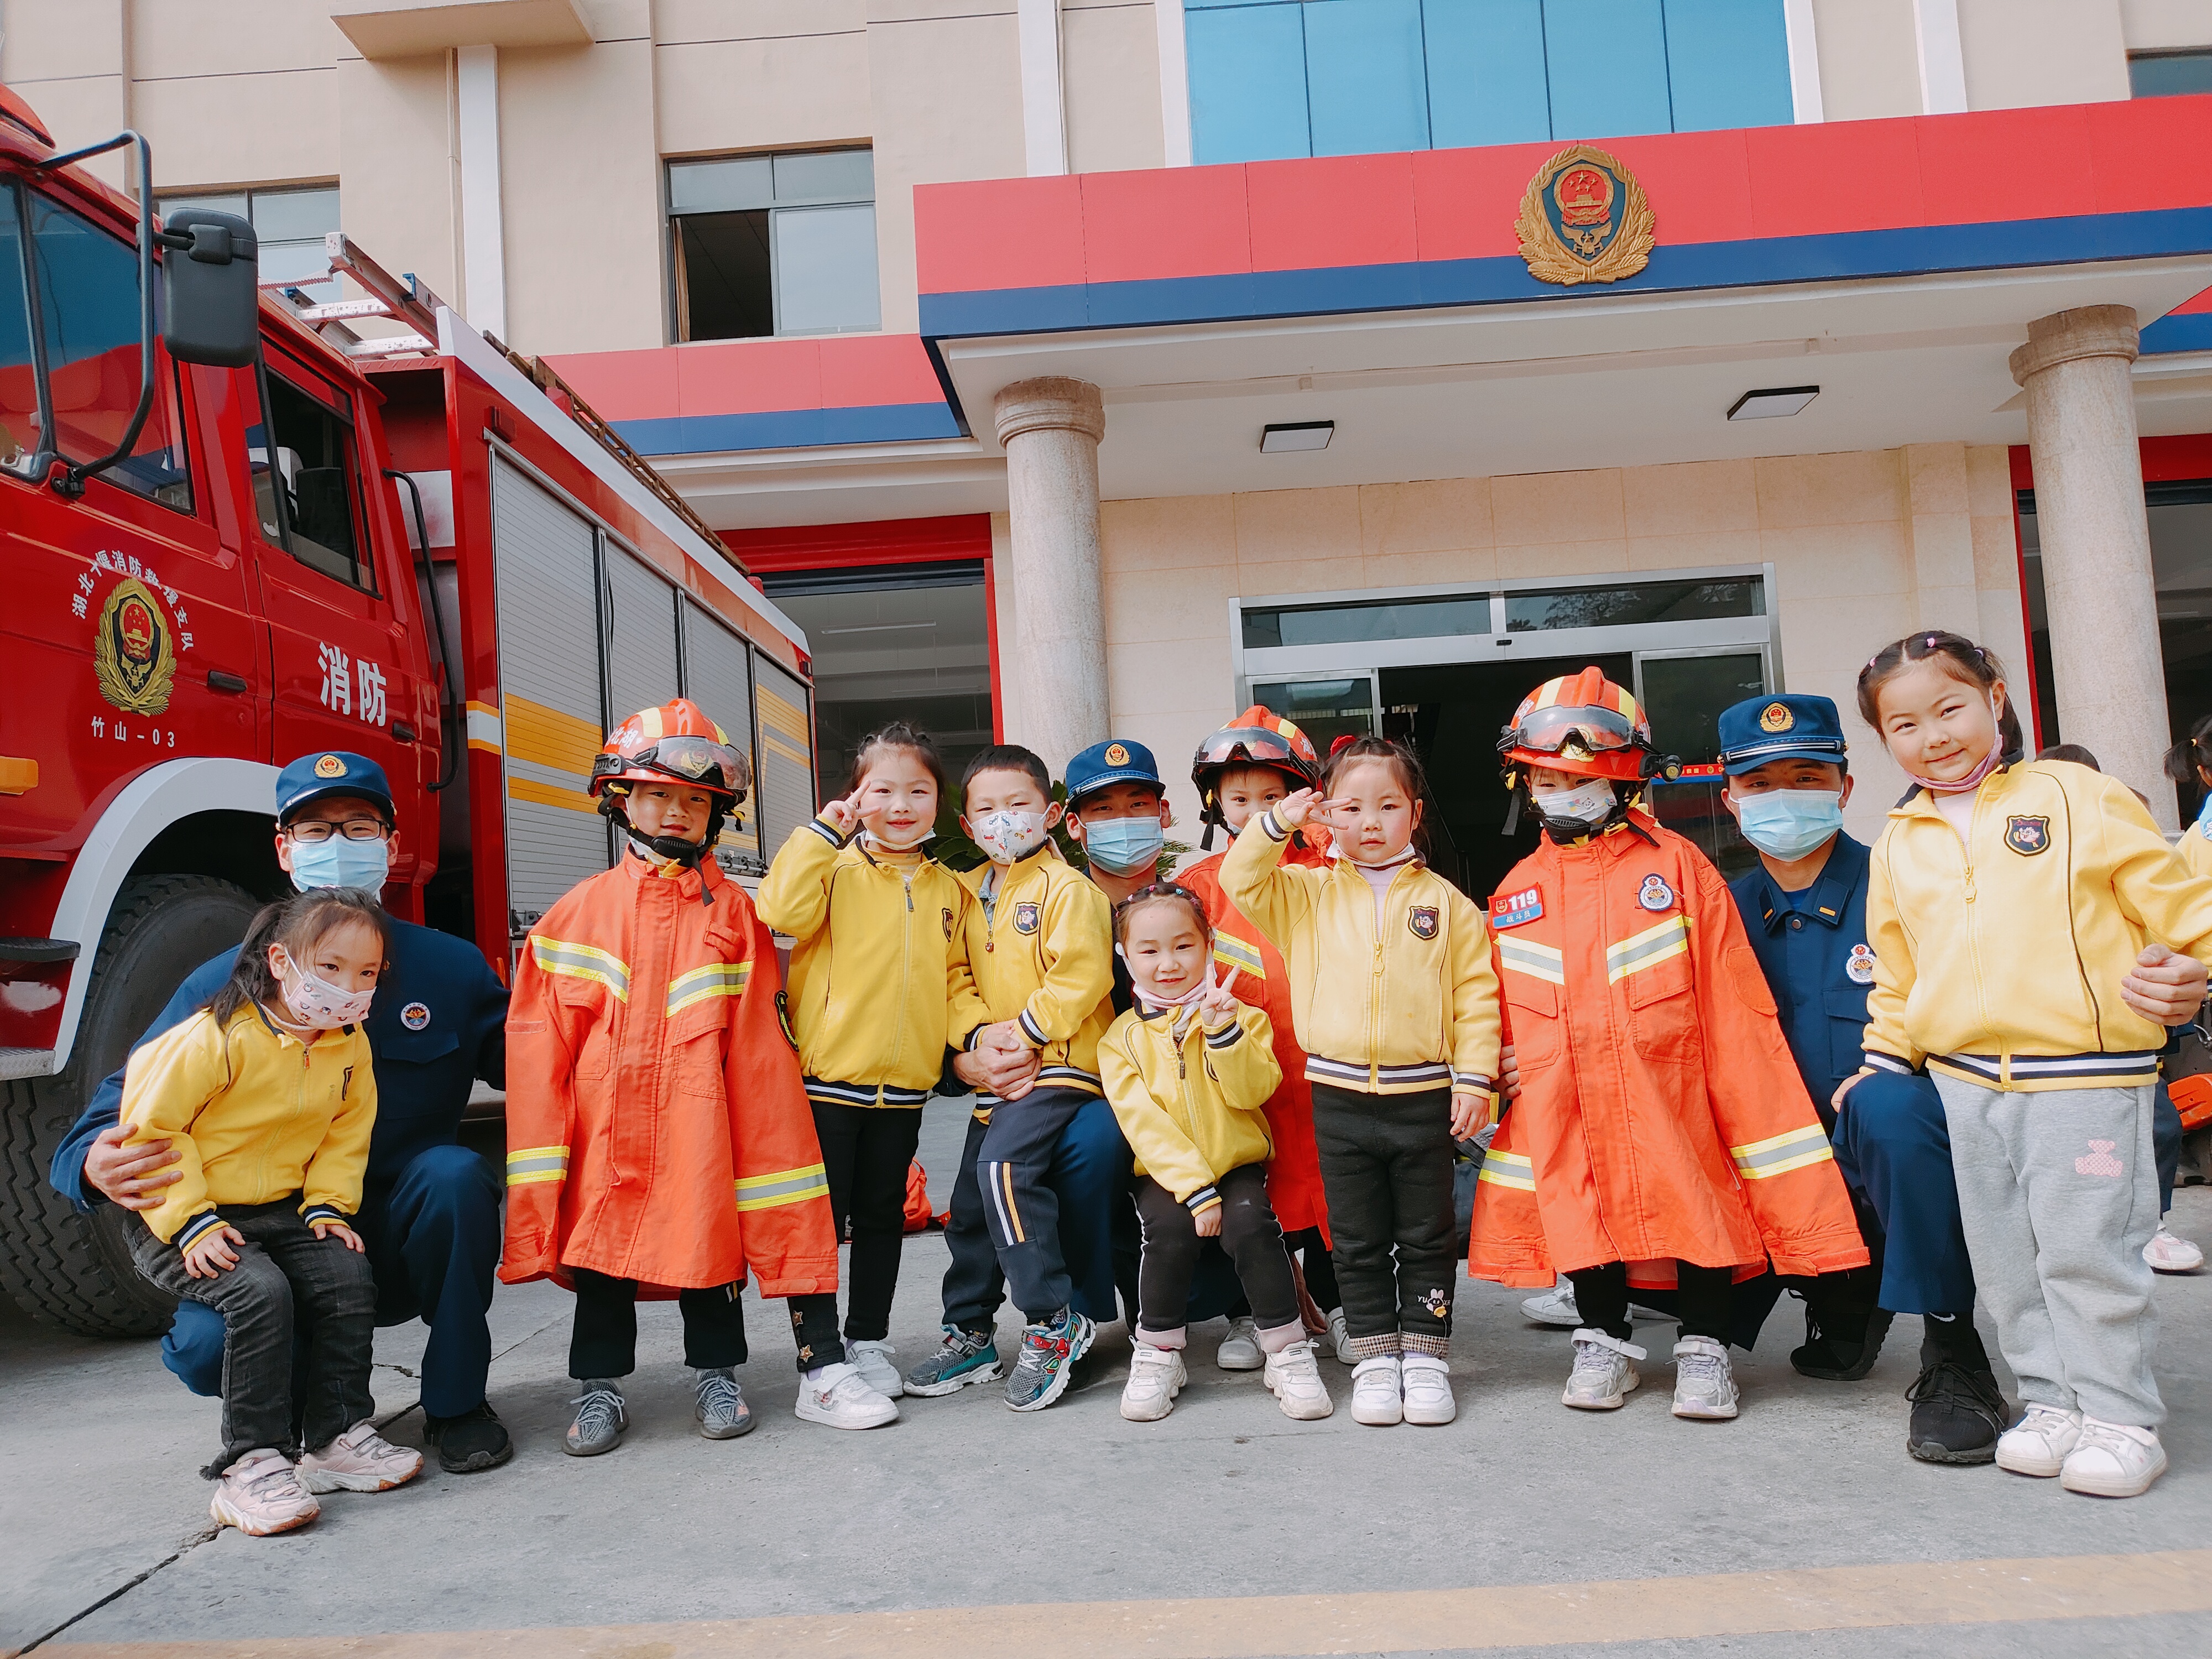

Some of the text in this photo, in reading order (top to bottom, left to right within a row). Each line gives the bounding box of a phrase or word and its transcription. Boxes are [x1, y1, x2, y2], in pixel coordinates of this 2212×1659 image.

[72, 550, 194, 652] 湖北十堰消防救援支队
[317, 641, 387, 727] 消防
[91, 716, 175, 748] 竹山-03
[1508, 889, 1537, 911] 119
[1506, 910, 1531, 923] 战斗员
[1417, 1295, 1428, 1303] YU
